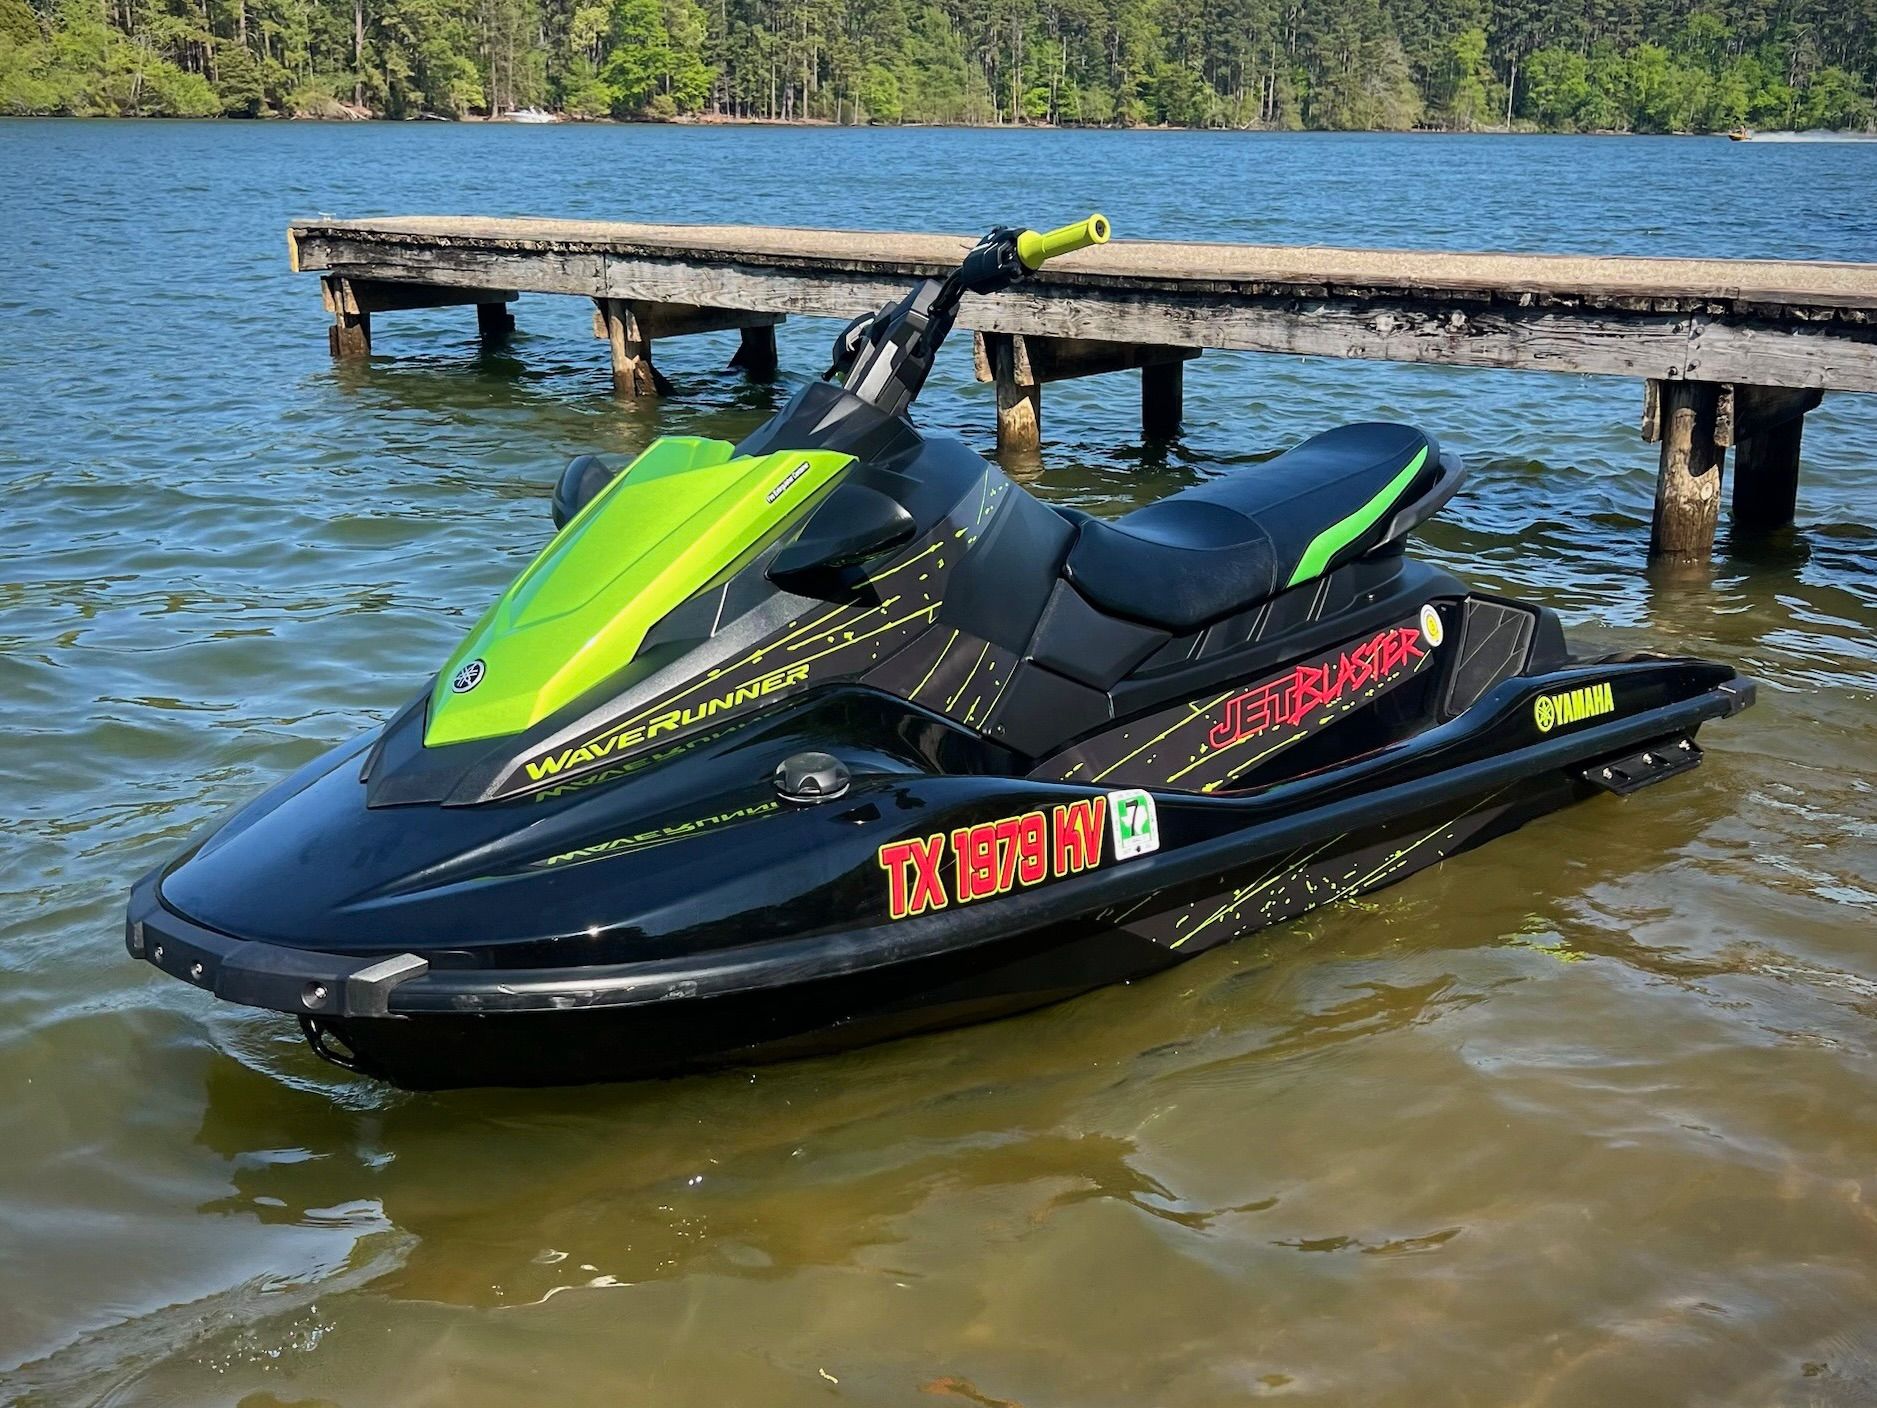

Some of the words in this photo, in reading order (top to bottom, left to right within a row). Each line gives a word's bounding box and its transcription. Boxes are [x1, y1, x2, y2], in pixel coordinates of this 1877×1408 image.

[525, 663, 810, 780] WAVERUNNER
[1551, 682, 1615, 726] YAMAHA
[878, 832, 948, 920] TX
[951, 810, 1047, 904] 1979
[1053, 795, 1108, 877] KV
[1125, 799, 1139, 836] 7
